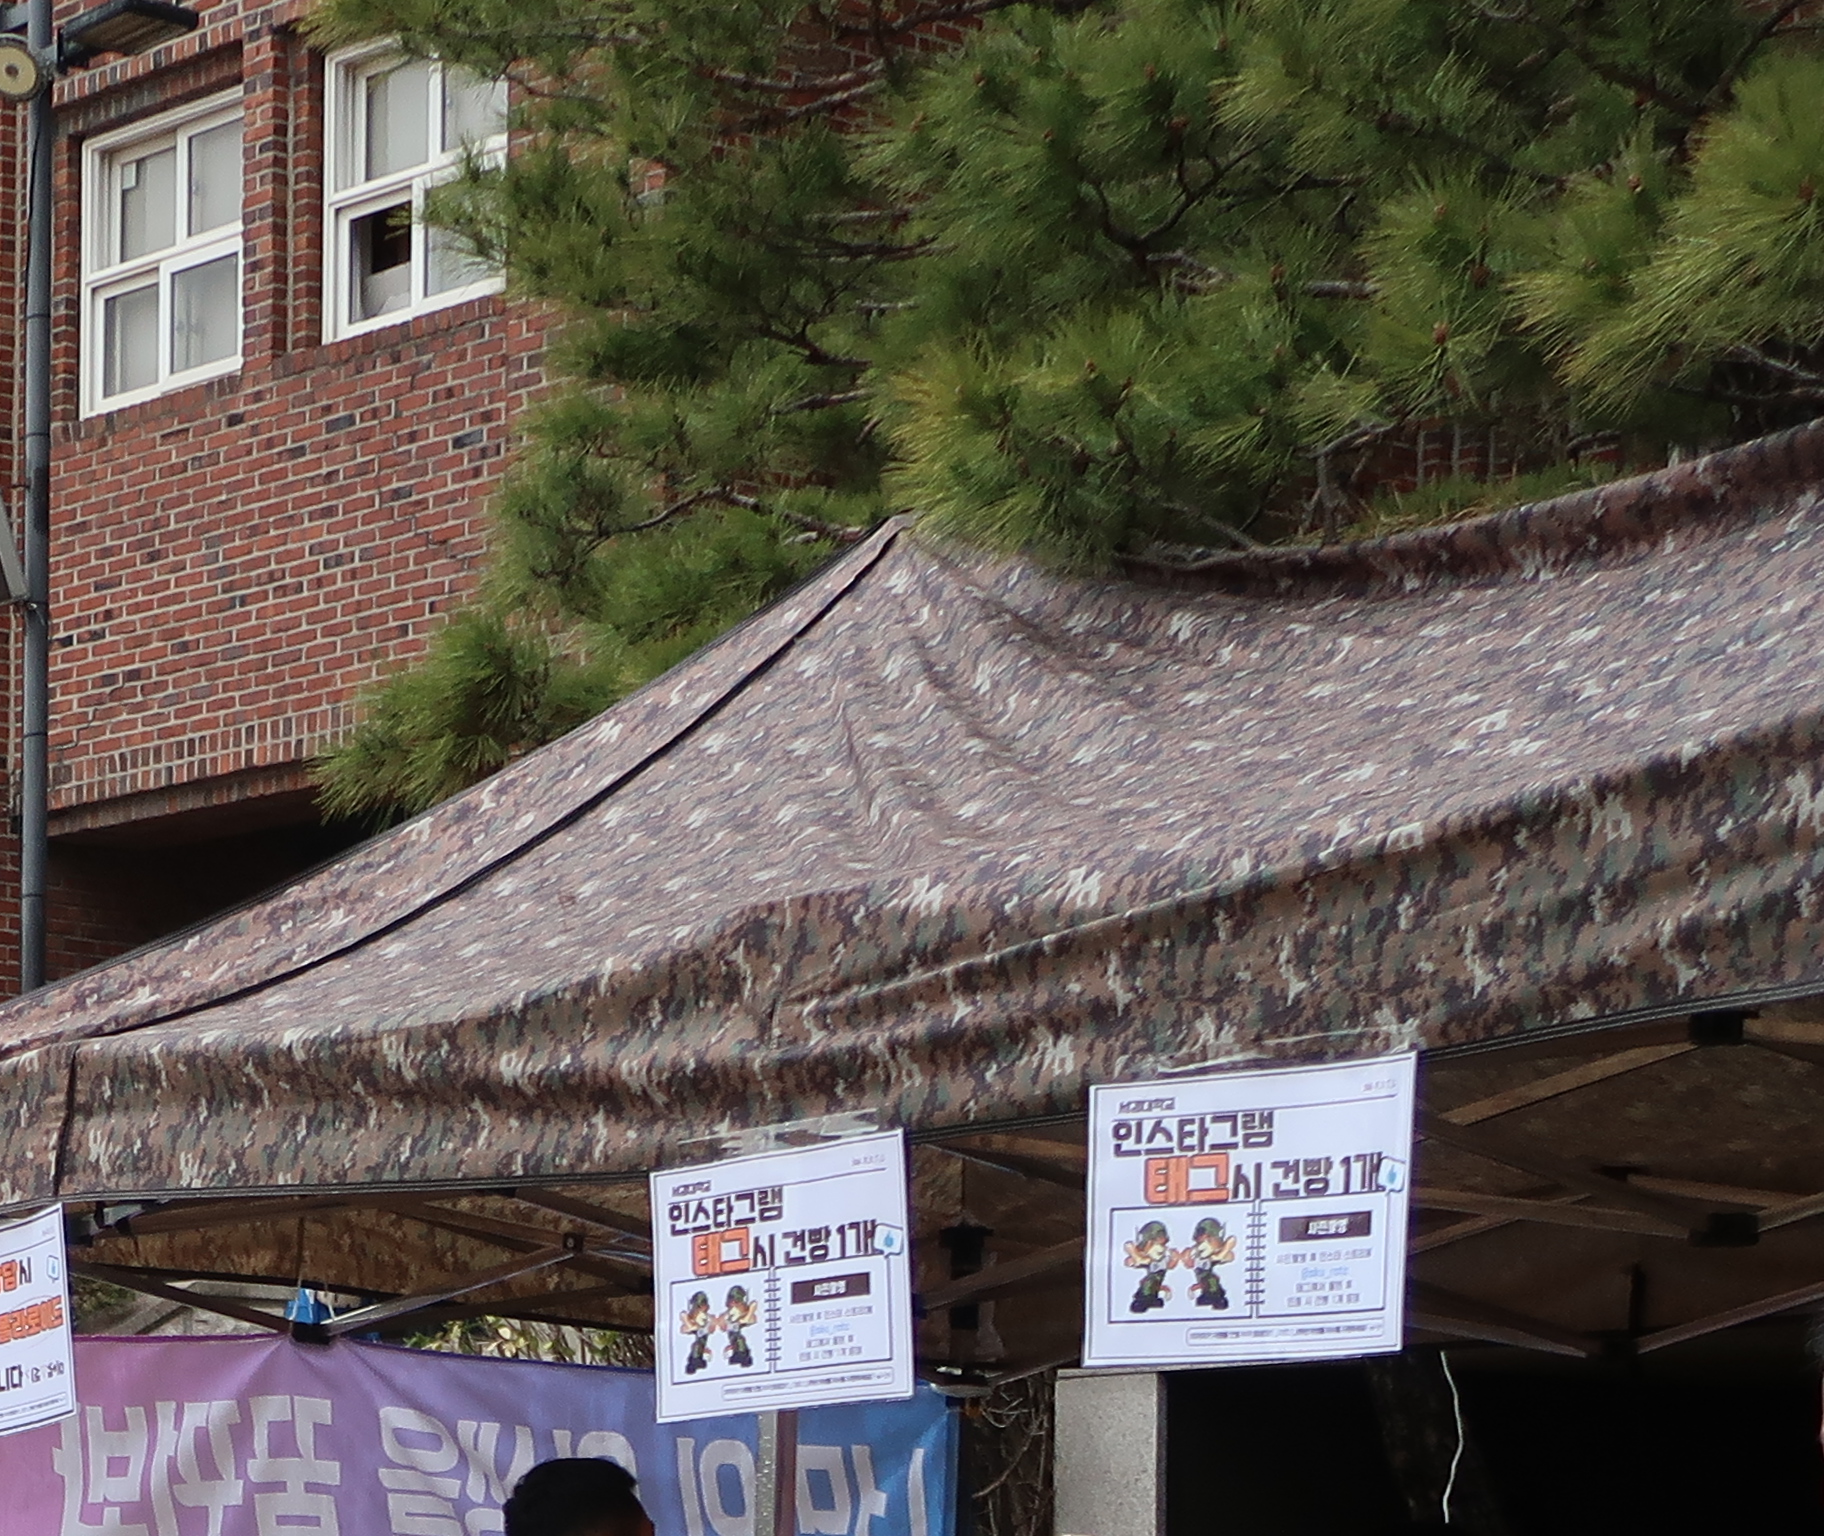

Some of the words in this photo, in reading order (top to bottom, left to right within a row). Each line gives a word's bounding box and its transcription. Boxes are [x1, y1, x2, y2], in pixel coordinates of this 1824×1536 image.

[1112, 1111, 1273, 1157] 인스타그램
[1271, 1156, 1333, 1197] 건빵
[669, 1187, 783, 1236] 인스타그램
[782, 1226, 831, 1264] 건빵
